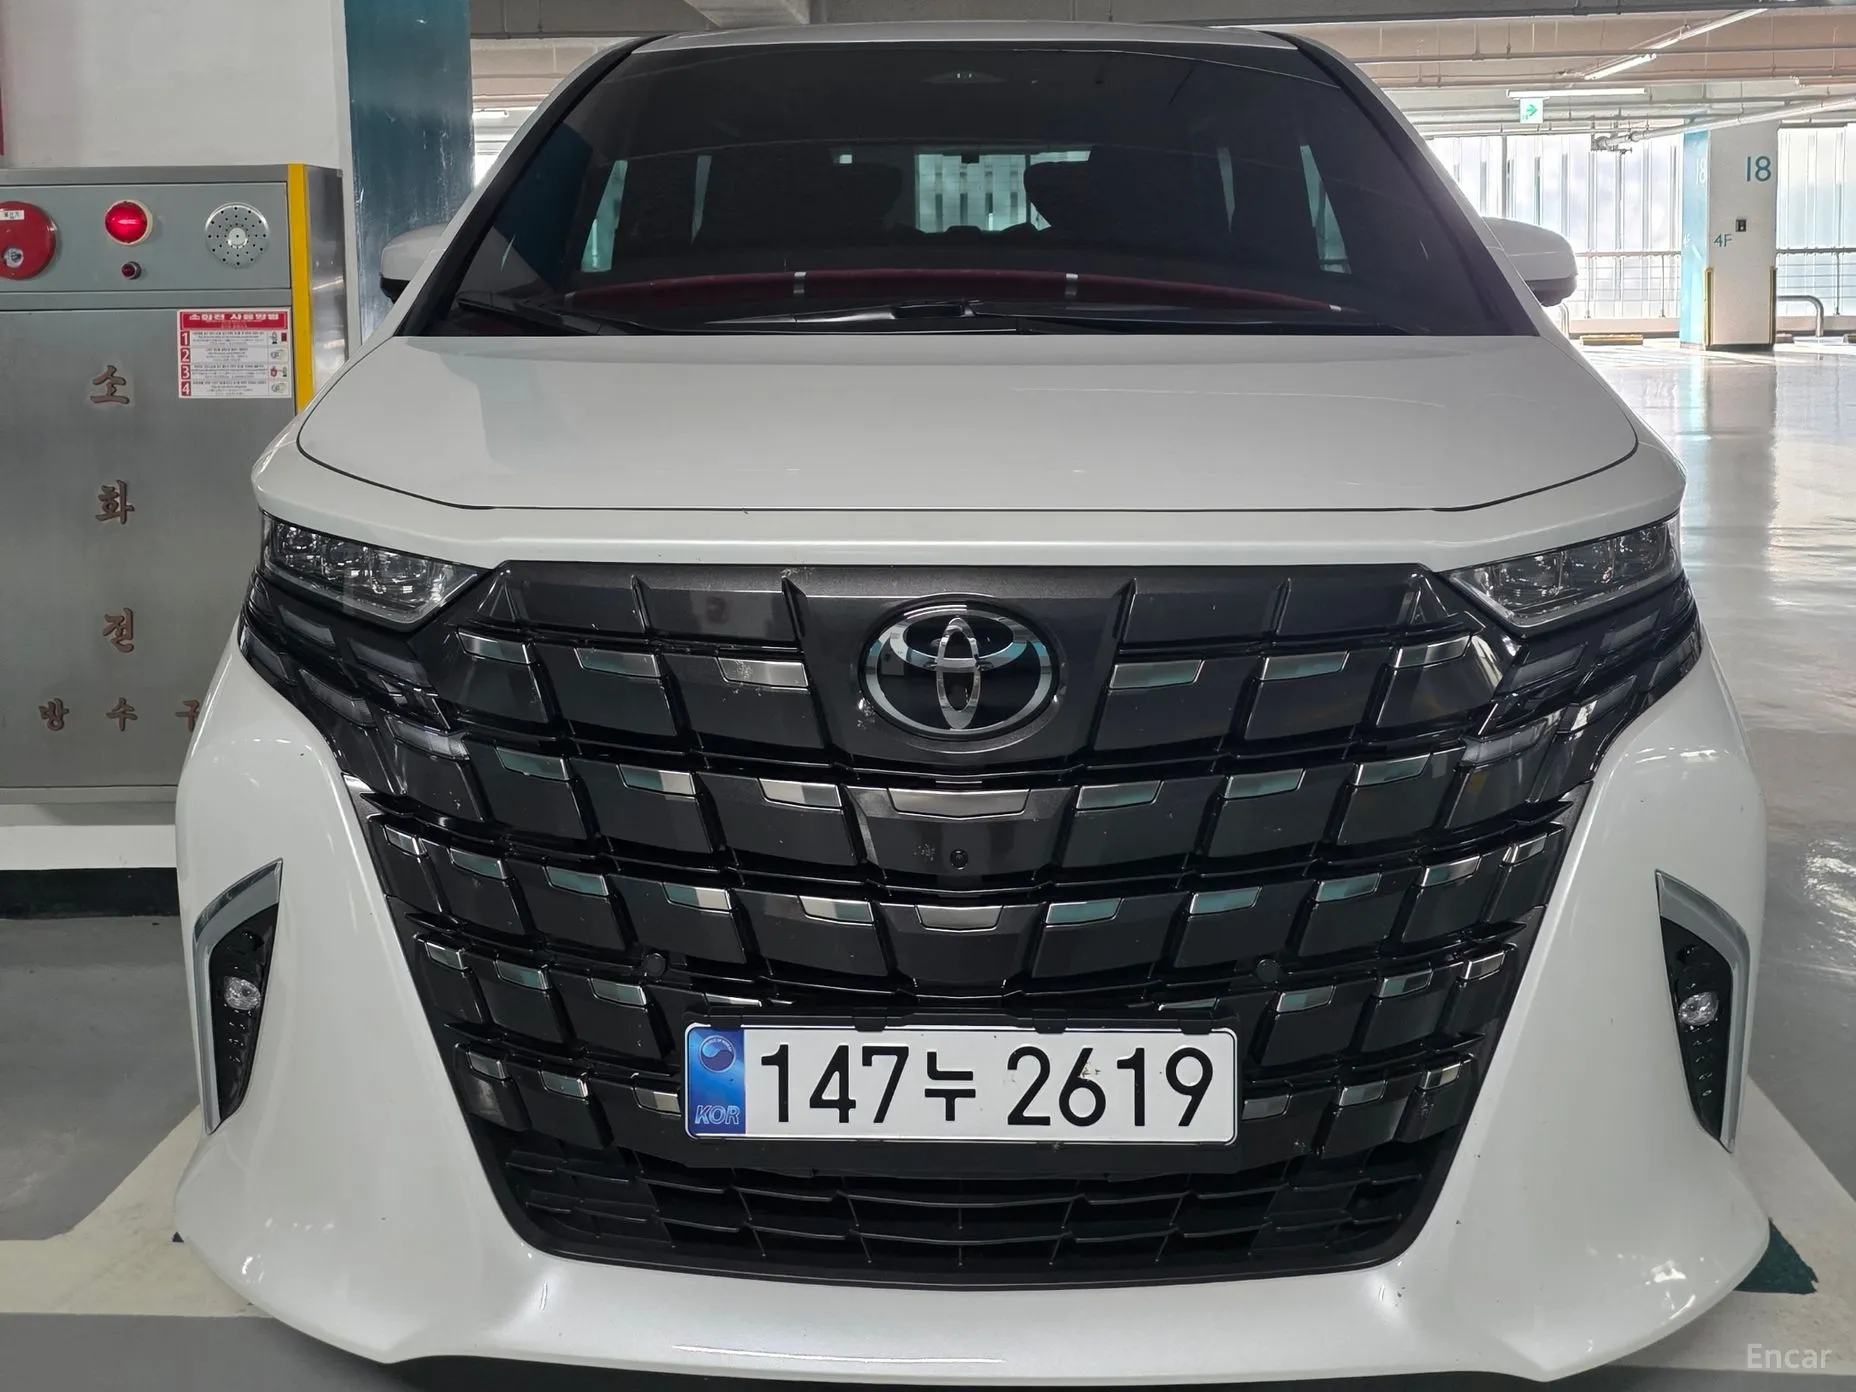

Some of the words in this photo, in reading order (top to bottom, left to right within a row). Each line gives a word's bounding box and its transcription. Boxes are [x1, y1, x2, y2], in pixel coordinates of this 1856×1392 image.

[1746, 155, 1771, 181] 18
[1713, 233, 1732, 247] 4F
[181, 331, 189, 346] 1
[181, 348, 190, 362] 2
[181, 365, 190, 379] 3
[181, 381, 190, 396] 4
[760, 1043, 977, 1124] 147누
[1006, 1046, 1214, 1128] 2619
[694, 1104, 741, 1125] KOR
